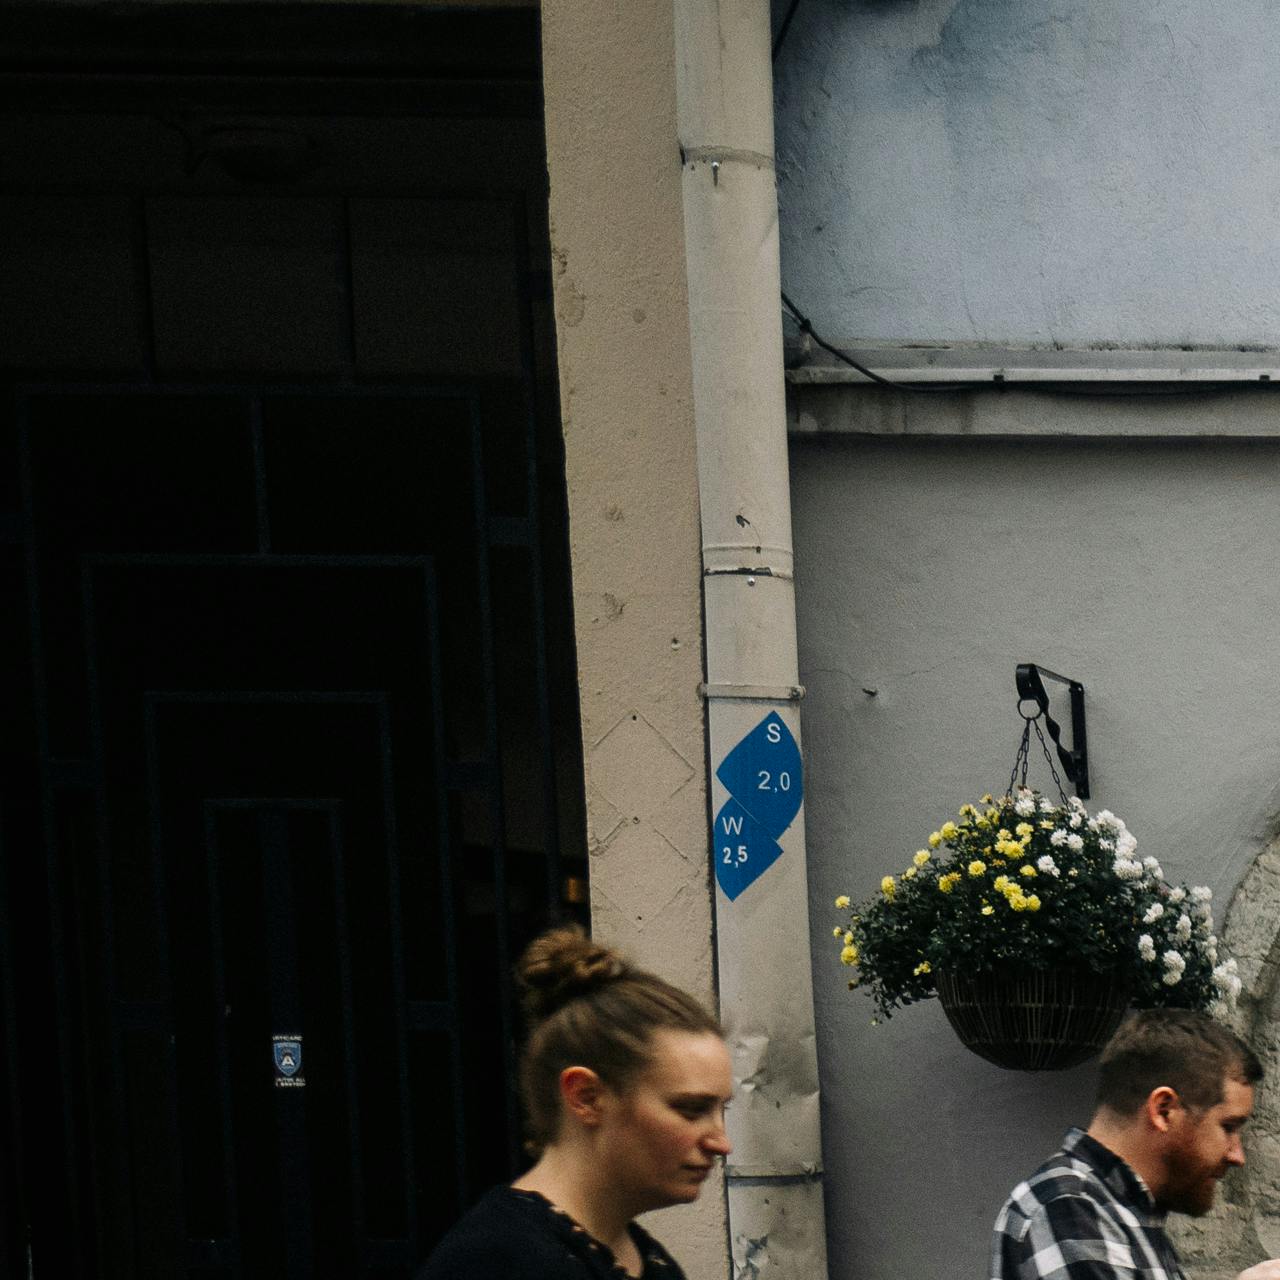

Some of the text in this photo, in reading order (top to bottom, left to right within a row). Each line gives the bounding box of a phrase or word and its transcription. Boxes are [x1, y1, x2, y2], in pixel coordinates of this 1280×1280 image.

[766, 722, 781, 743] S
[757, 770, 791, 793] 2,0
[722, 816, 744, 836] W
[722, 845, 748, 868] 2,5
